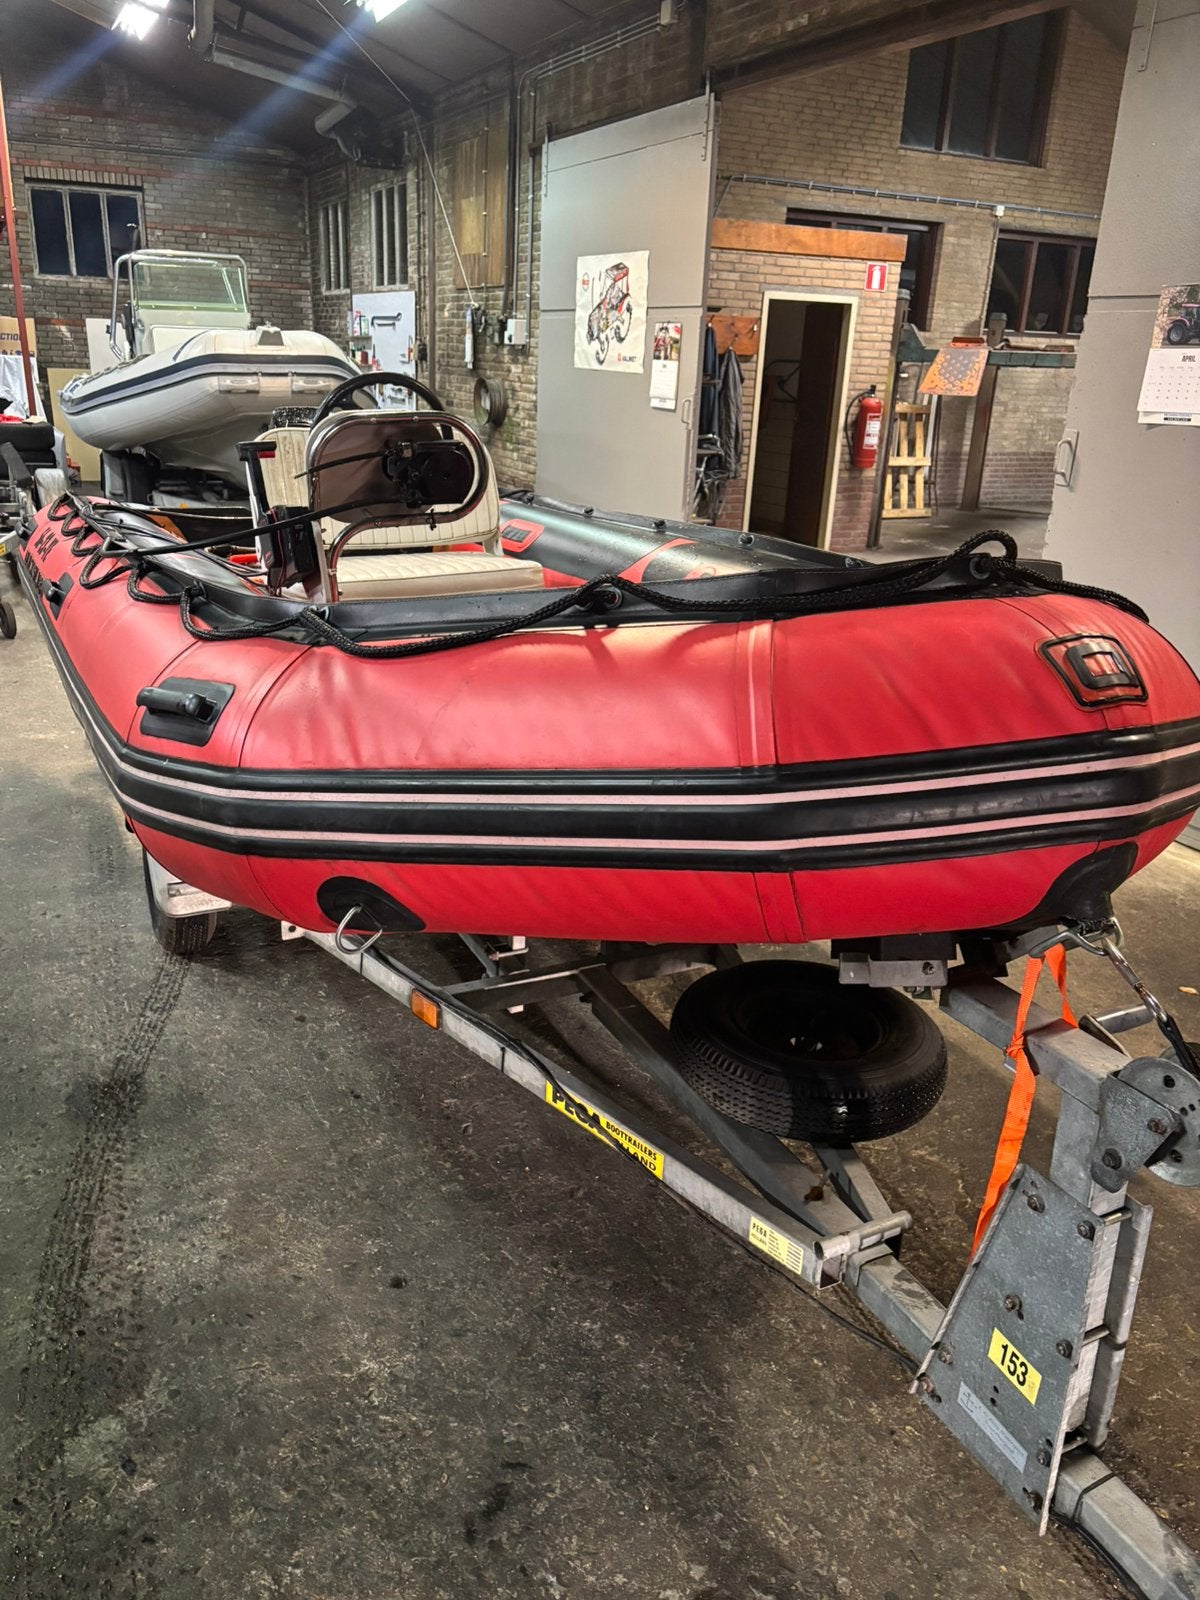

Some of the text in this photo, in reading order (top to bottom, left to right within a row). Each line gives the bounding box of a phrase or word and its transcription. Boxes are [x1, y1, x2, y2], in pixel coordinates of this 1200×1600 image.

[0, 332, 19, 341] CTIO
[606, 1121, 657, 1161] BOOTTRAILERS
[1000, 1343, 1029, 1387] 153
